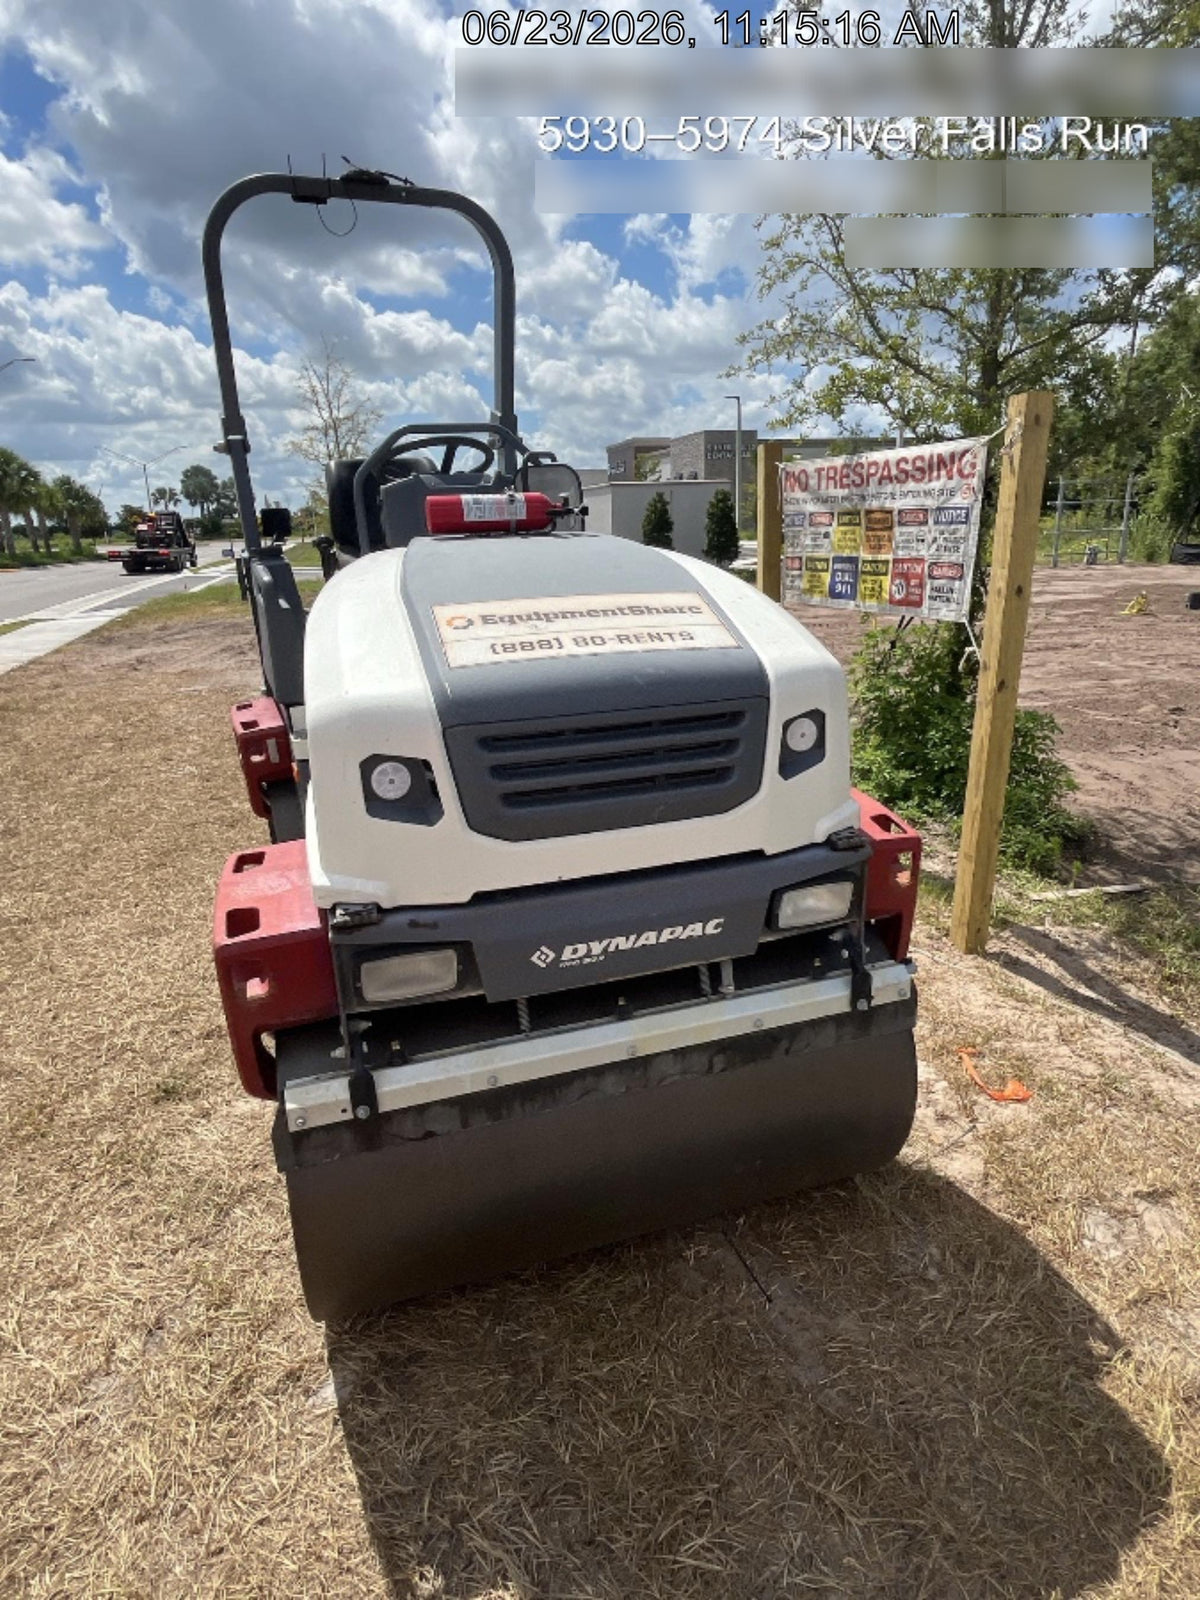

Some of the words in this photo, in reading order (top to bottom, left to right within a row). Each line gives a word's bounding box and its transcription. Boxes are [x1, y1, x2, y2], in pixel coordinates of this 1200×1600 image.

[784, 467, 809, 493] NO
[814, 449, 978, 491] TRESPASSING
[835, 582, 851, 595] 911
[478, 604, 704, 627] EquipmentShare
[490, 637, 565, 655] (888)
[573, 630, 695, 648] 80-RENTS
[561, 918, 725, 961] DYNAPAC
